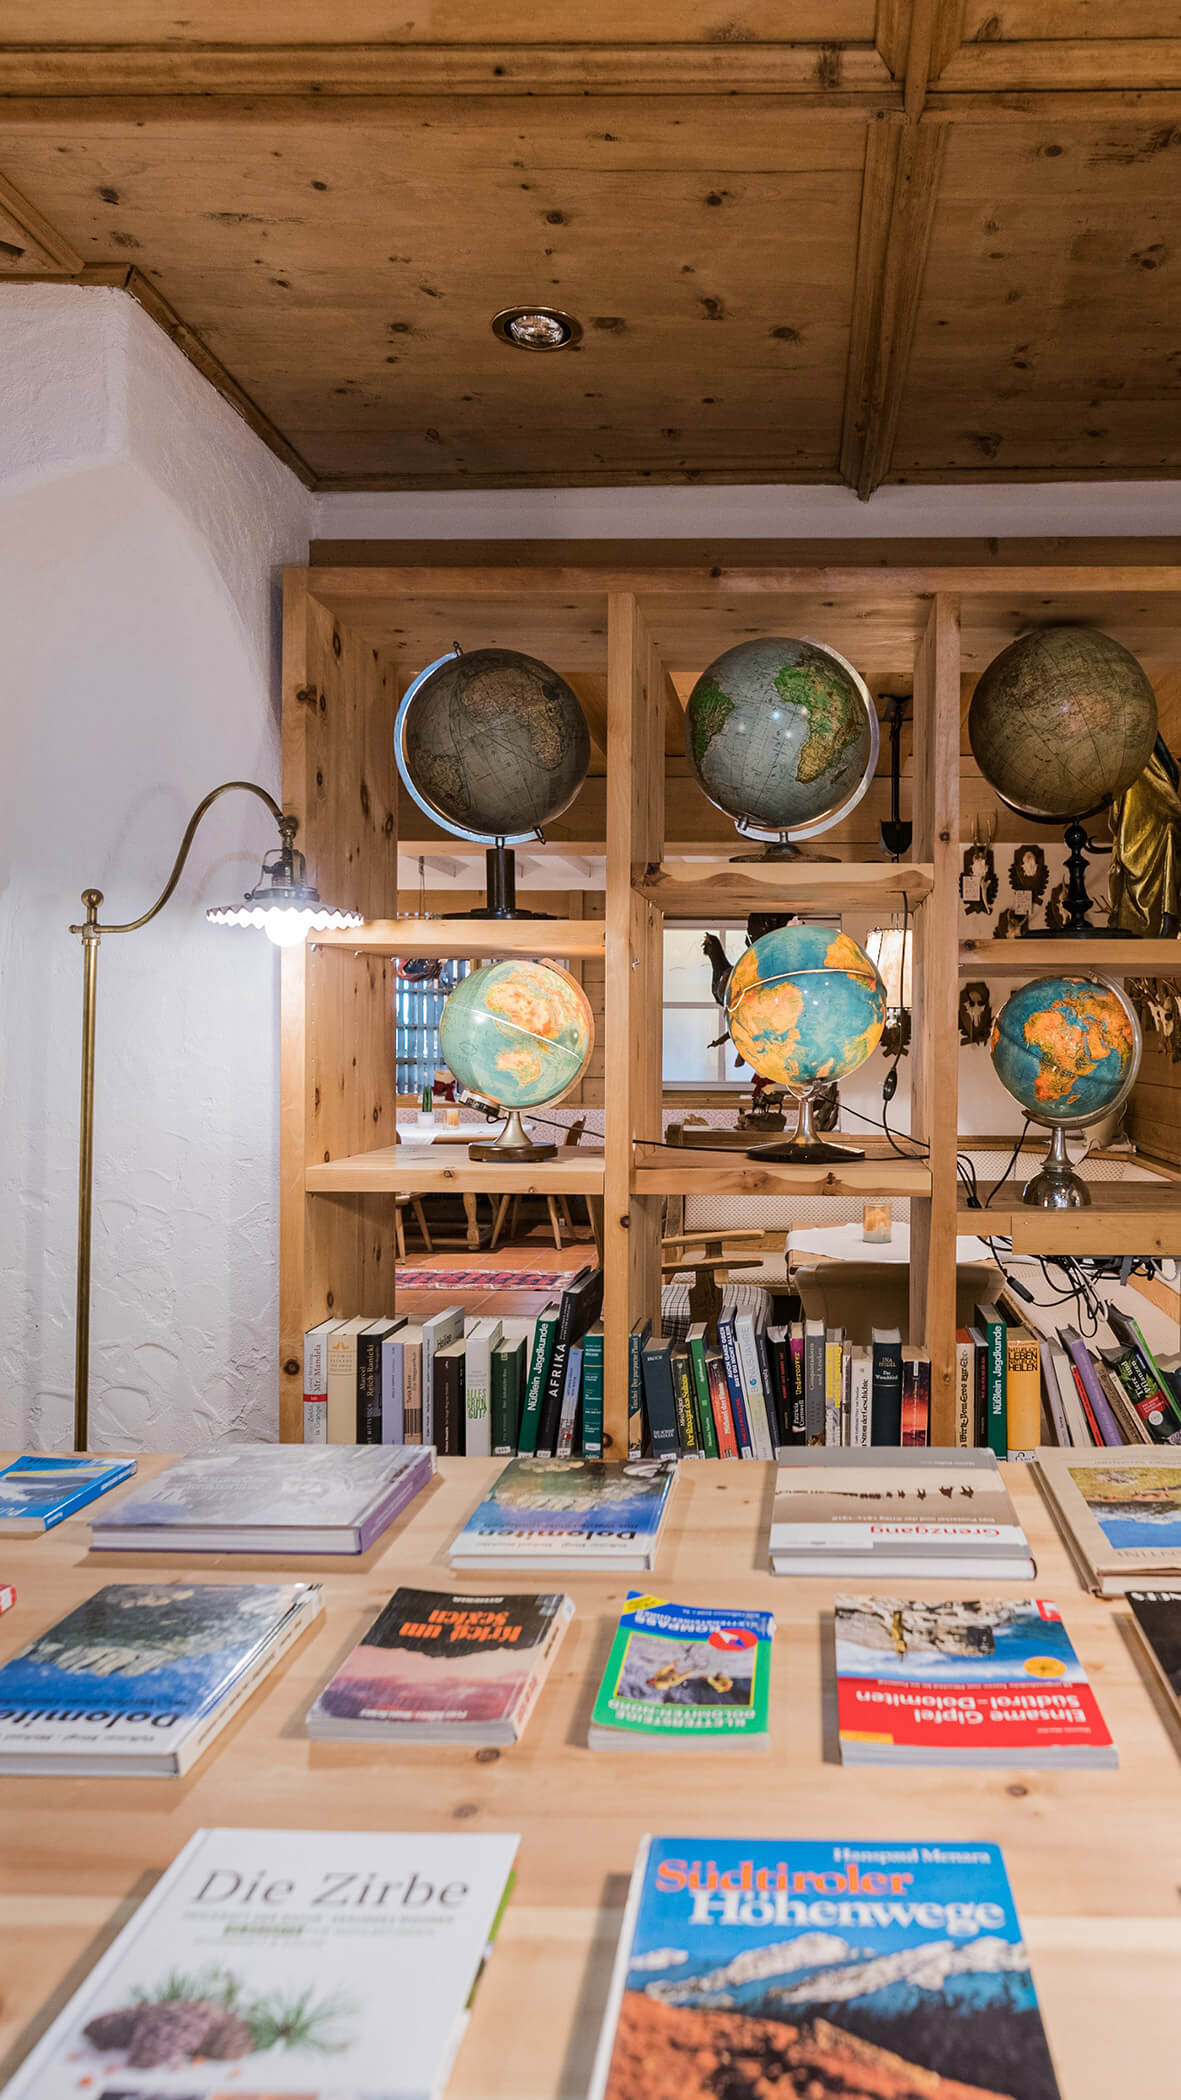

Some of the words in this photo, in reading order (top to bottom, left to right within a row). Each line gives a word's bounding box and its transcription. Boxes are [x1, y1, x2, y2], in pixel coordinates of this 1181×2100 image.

[719, 1326, 727, 1343] OBEN
[724, 1325, 733, 1345] ALLEIN
[313, 1344, 321, 1376] Mandela
[722, 1344, 730, 1360] GANZ
[728, 1346, 736, 1363] NICHT
[994, 1326, 1003, 1377] Jagdkunde
[527, 1376, 540, 1411] Nüßlein
[535, 1323, 549, 1374] Jagdkunde
[548, 1343, 566, 1398] AFRIKA
[725, 1361, 733, 1378] AUCH
[731, 1363, 737, 1372] DU
[1130, 1358, 1151, 1393] Pflanzen
[860, 1379, 869, 1414] Geschichte
[992, 1380, 1001, 1415] Nüßlein
[477, 1529, 636, 1540] Dolomiten
[870, 1525, 1000, 1537] Grenzgang
[400, 1622, 442, 1639] um
[634, 1613, 721, 1633] KOMPASS
[0, 1710, 181, 1728] Dolomite
[914, 1708, 984, 1725] Gipfel
[990, 1709, 1087, 1723] Einsame
[833, 1847, 919, 1865] Hanspaul
[922, 1848, 991, 1864] Menara
[655, 1858, 914, 1896] Südtiroler
[192, 1868, 295, 1906] Die
[311, 1871, 470, 1907] Zirbe
[688, 1889, 1006, 1937] Höhenwege
